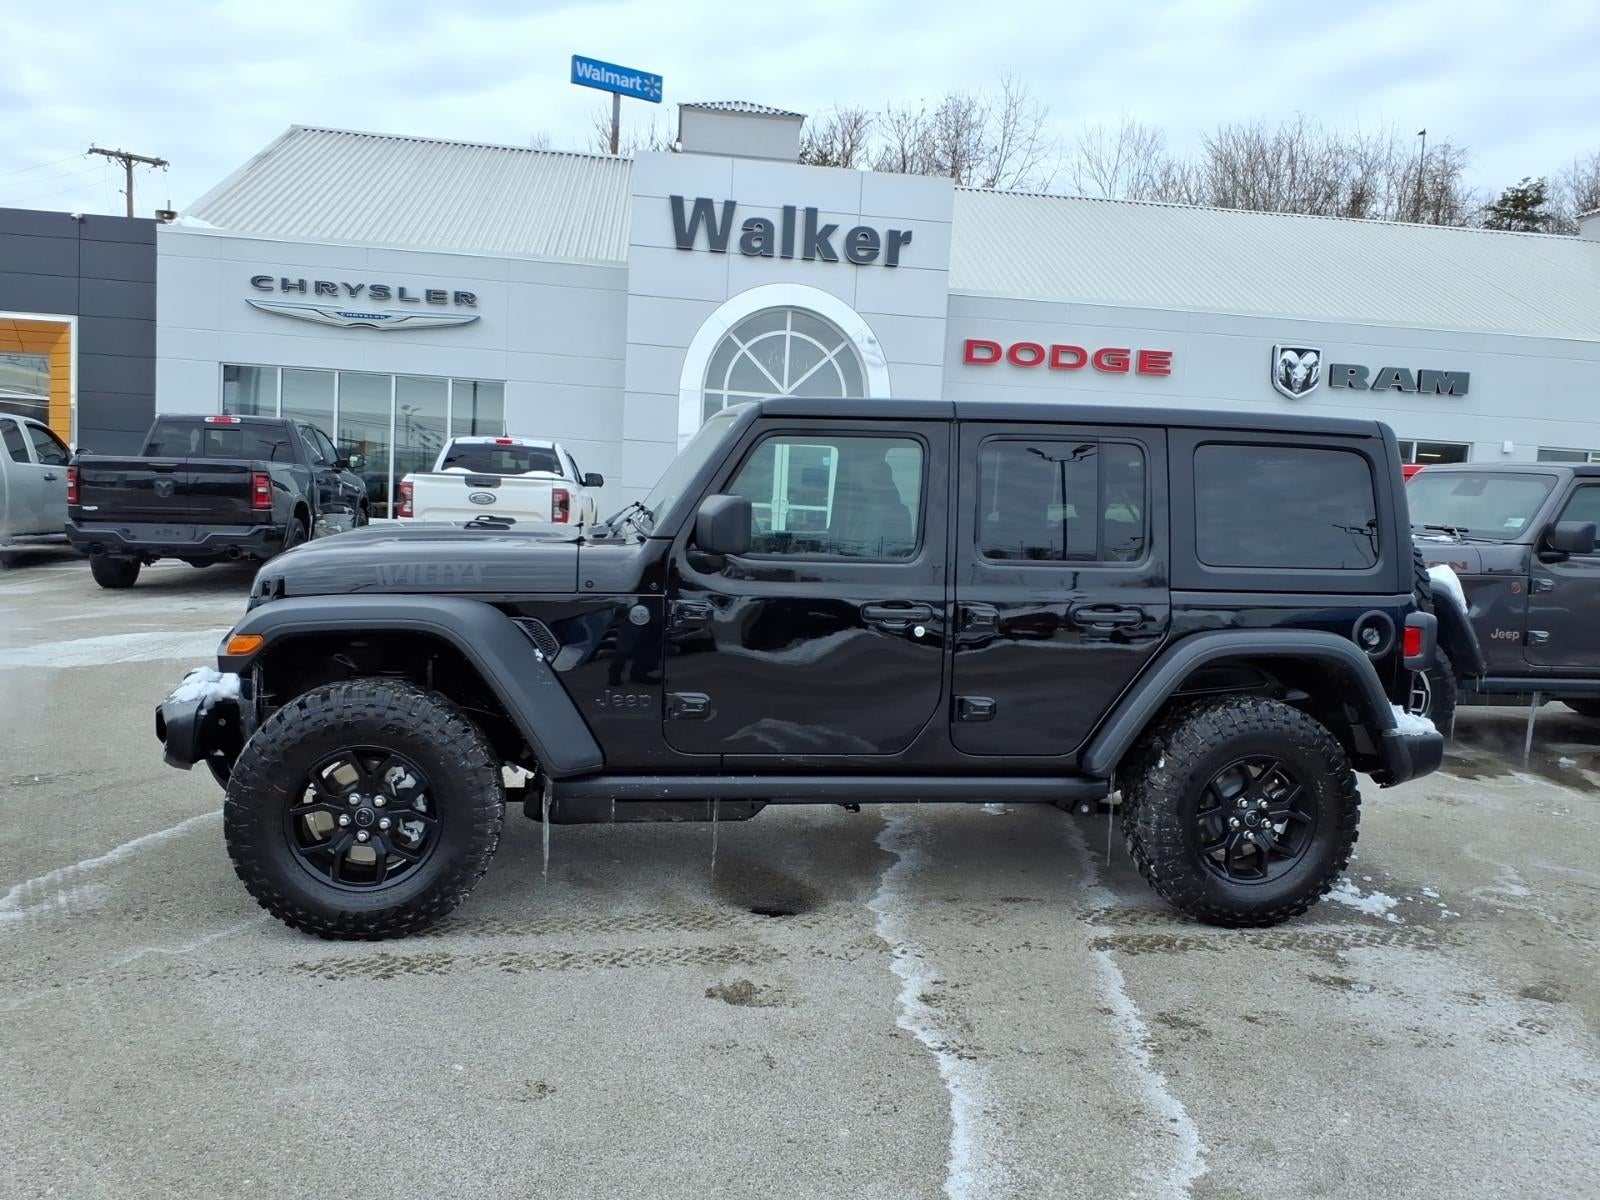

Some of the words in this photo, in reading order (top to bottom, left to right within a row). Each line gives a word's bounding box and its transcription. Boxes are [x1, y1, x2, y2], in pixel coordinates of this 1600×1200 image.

[576, 61, 643, 91] Walmart
[669, 195, 913, 267] Walker
[250, 275, 478, 307] CHRYSLER
[963, 339, 1173, 376] DODGE
[1329, 363, 1471, 395] RAM
[1491, 628, 1520, 640] Jeep
